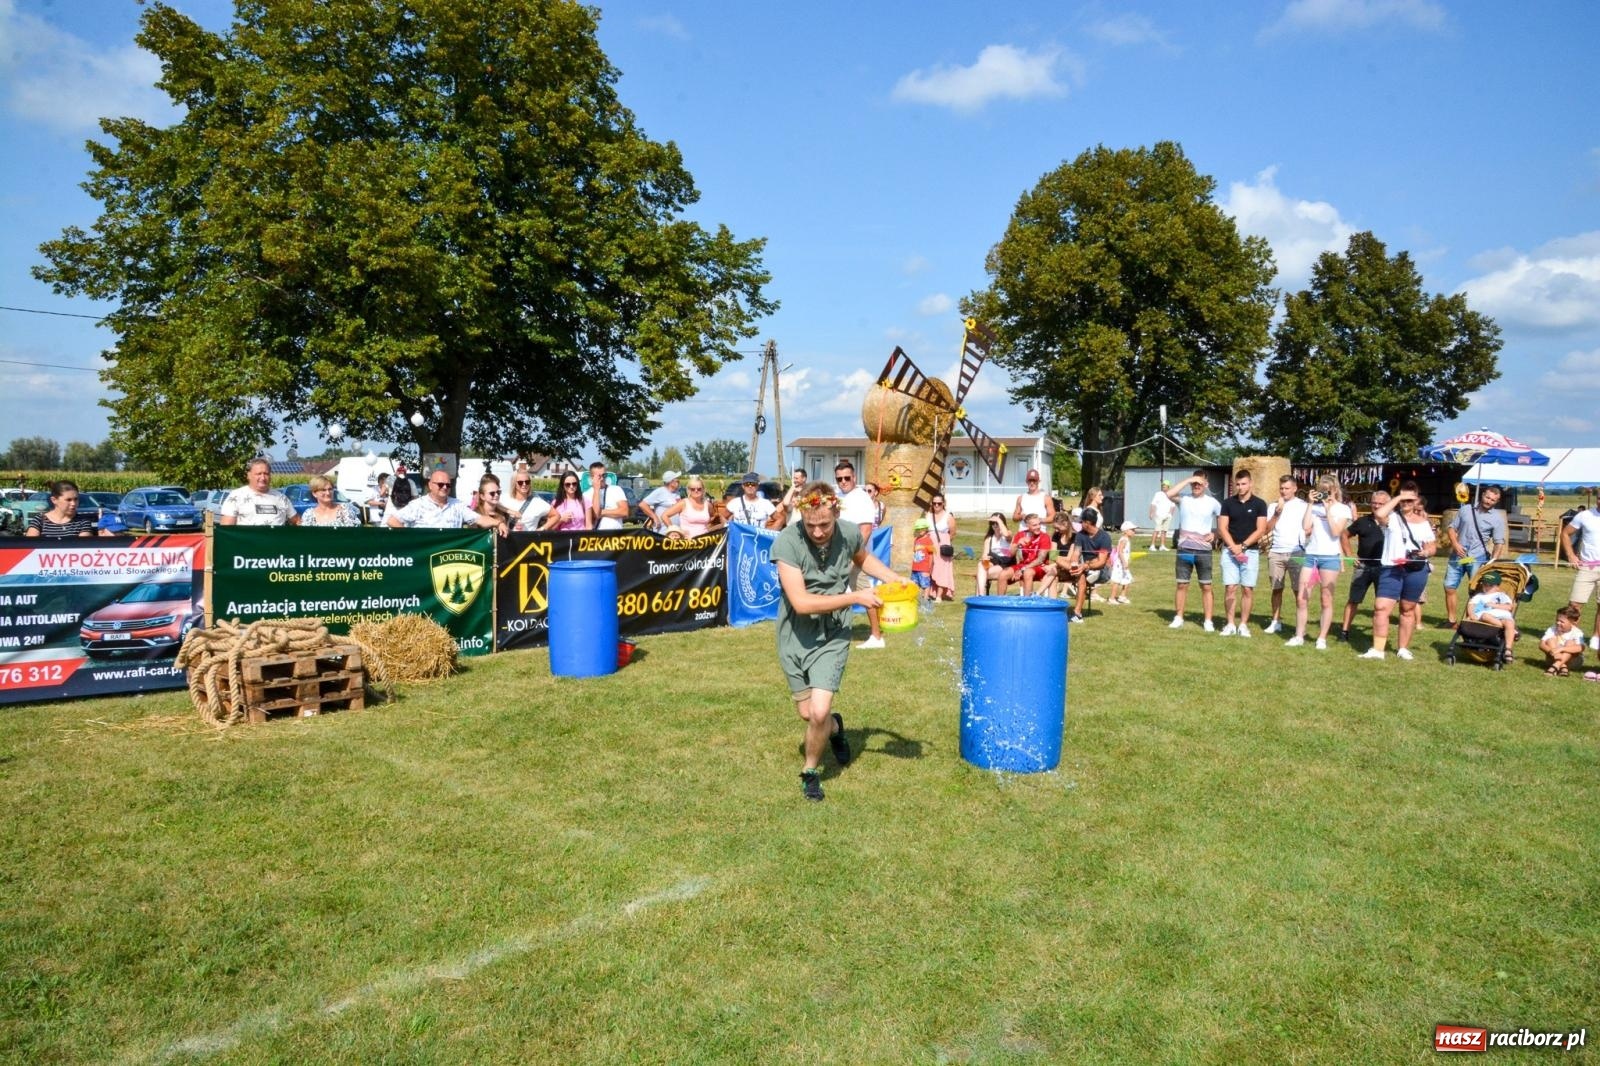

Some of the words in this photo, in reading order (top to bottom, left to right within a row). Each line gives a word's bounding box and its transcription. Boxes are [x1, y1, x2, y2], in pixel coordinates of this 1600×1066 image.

[578, 536, 654, 552] DEKARSTWO
[38, 550, 187, 568] WYPOŻYCZALNIA
[233, 555, 296, 570] Drzewka
[300, 555, 304, 569] i
[307, 554, 354, 572] krzewy
[359, 553, 413, 568] ozdobne
[439, 553, 476, 564] JODEŁKA
[70, 567, 111, 577] Sławików
[113, 567, 122, 576] ul.
[126, 565, 178, 576] Słowackiego
[179, 565, 189, 574] 41
[269, 570, 313, 583] Okrasné
[316, 571, 351, 584] stromy
[352, 572, 359, 581] a
[362, 569, 383, 581] keře
[0, 595, 12, 606] IA
[15, 594, 38, 606] AUT
[227, 600, 297, 617] Aranżacja
[300, 596, 358, 611] terenów
[361, 594, 420, 611] zielonych
[651, 588, 685, 613] 667
[688, 584, 722, 609] 860
[0, 616, 12, 627] IA
[15, 613, 80, 627] AUTOLAWET
[321, 612, 363, 626] zelených
[24, 635, 45, 647] 24H
[455, 635, 484, 650] .info
[0, 667, 23, 685] 76
[28, 664, 63, 683] 312
